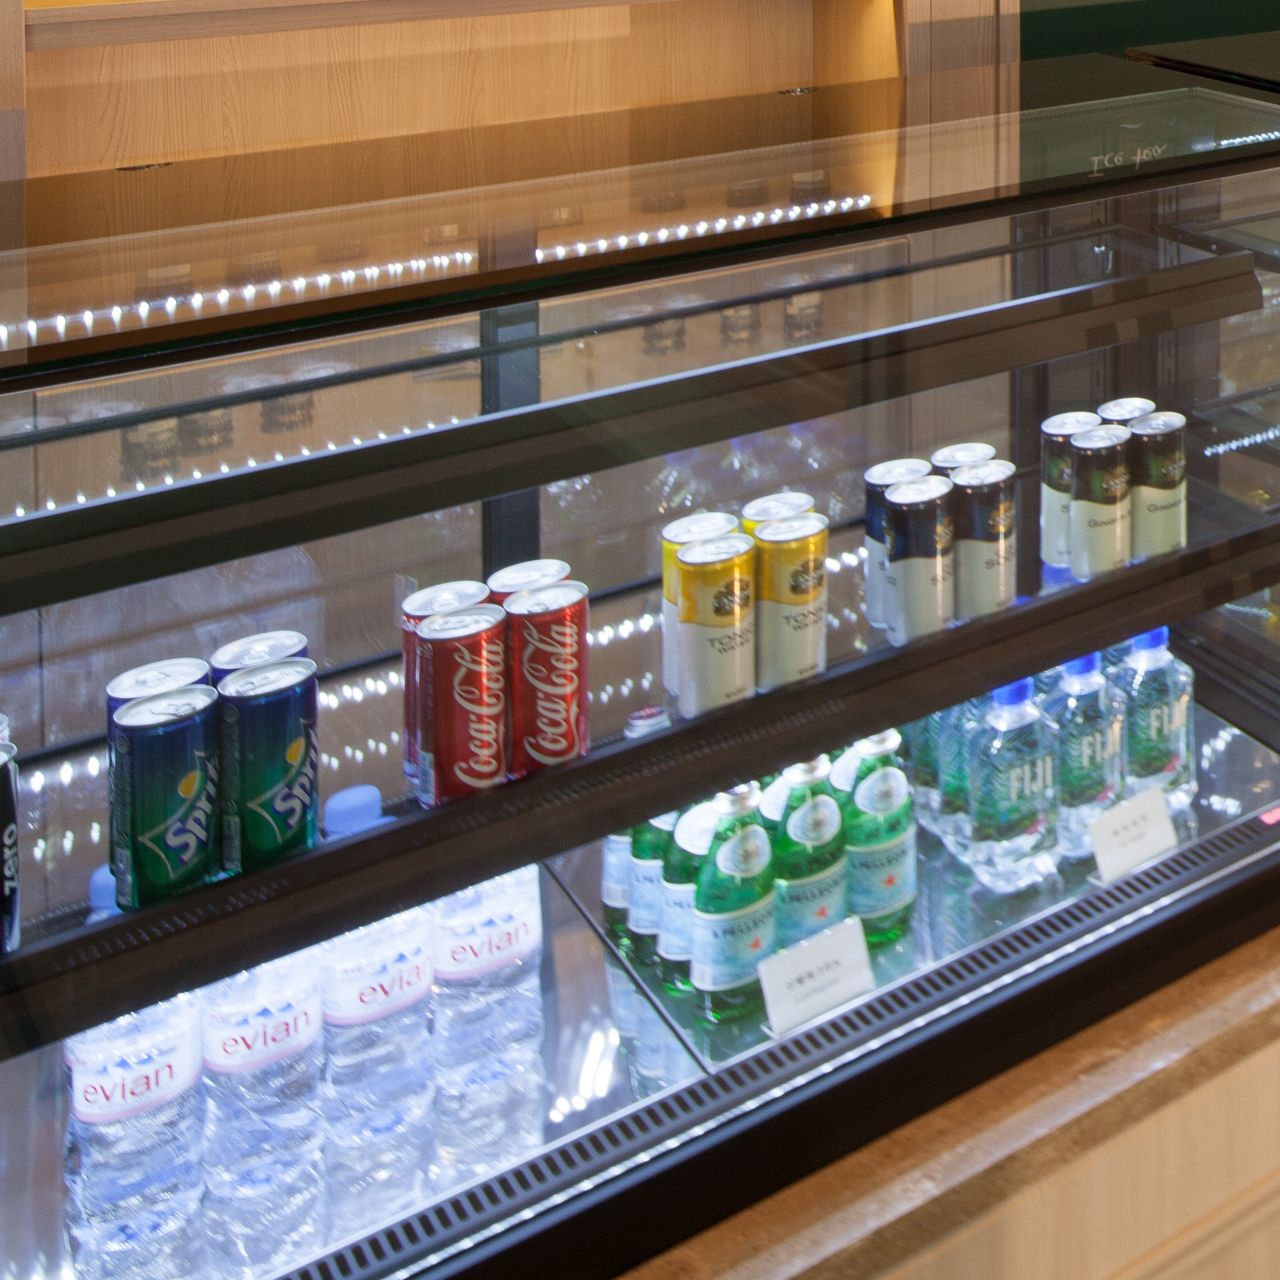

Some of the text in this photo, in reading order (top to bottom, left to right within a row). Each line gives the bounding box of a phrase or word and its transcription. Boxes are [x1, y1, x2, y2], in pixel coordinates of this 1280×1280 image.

[1081, 720, 1121, 770] FIJI
[1009, 755, 1053, 804] FIJI
[451, 921, 529, 963] evian
[222, 1010, 311, 1056] evian
[83, 1062, 175, 1104] evian
